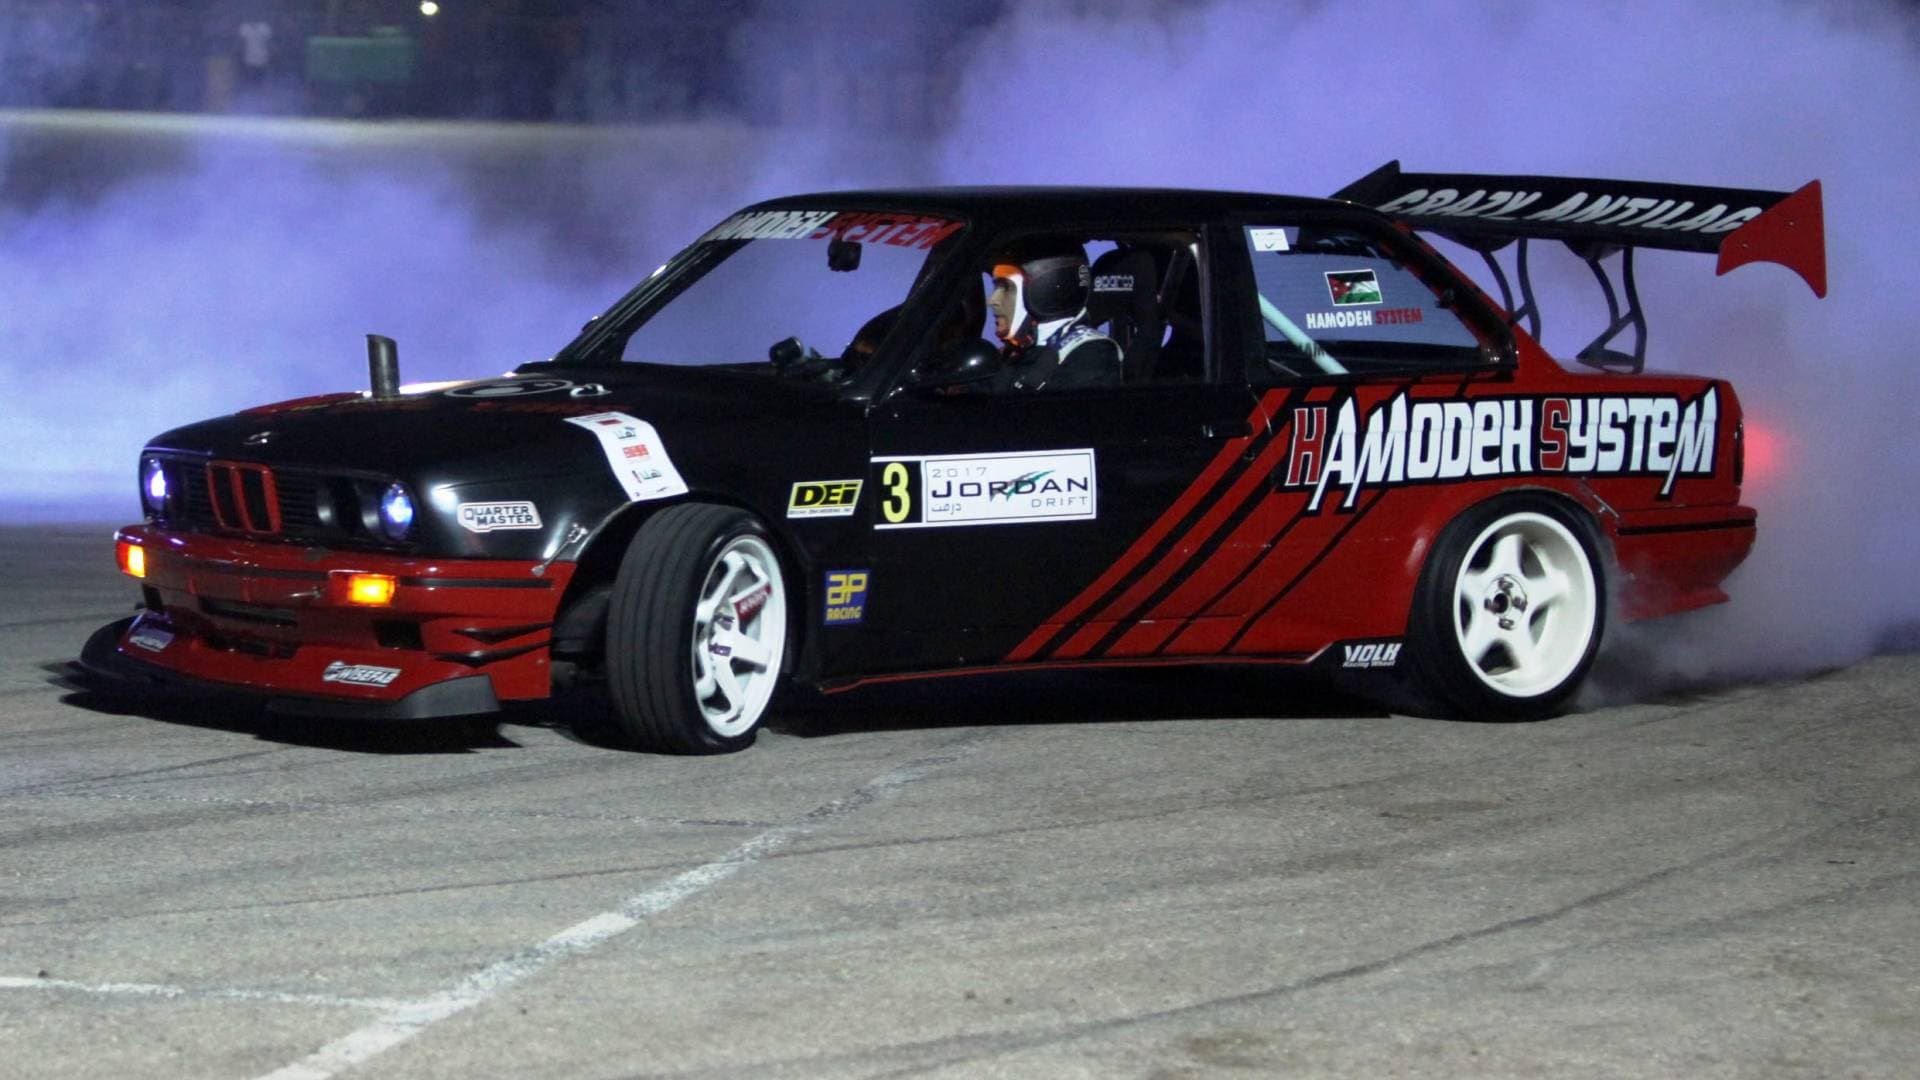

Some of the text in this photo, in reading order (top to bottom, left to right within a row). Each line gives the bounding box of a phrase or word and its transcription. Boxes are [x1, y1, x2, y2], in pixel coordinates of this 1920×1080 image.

[1376, 189, 1762, 233] CRAZY ANTILAG
[1306, 307, 1424, 329] HAMODEH SYSTEM
[932, 467, 987, 478] 2017
[883, 462, 911, 523] 3
[931, 477, 1088, 499] JORDAN
[1031, 497, 1088, 508] DRIFT
[464, 506, 529, 520] QUARTER
[477, 515, 533, 525] MASTER
[826, 606, 862, 621] RACING
[1344, 643, 1402, 662] VOLK
